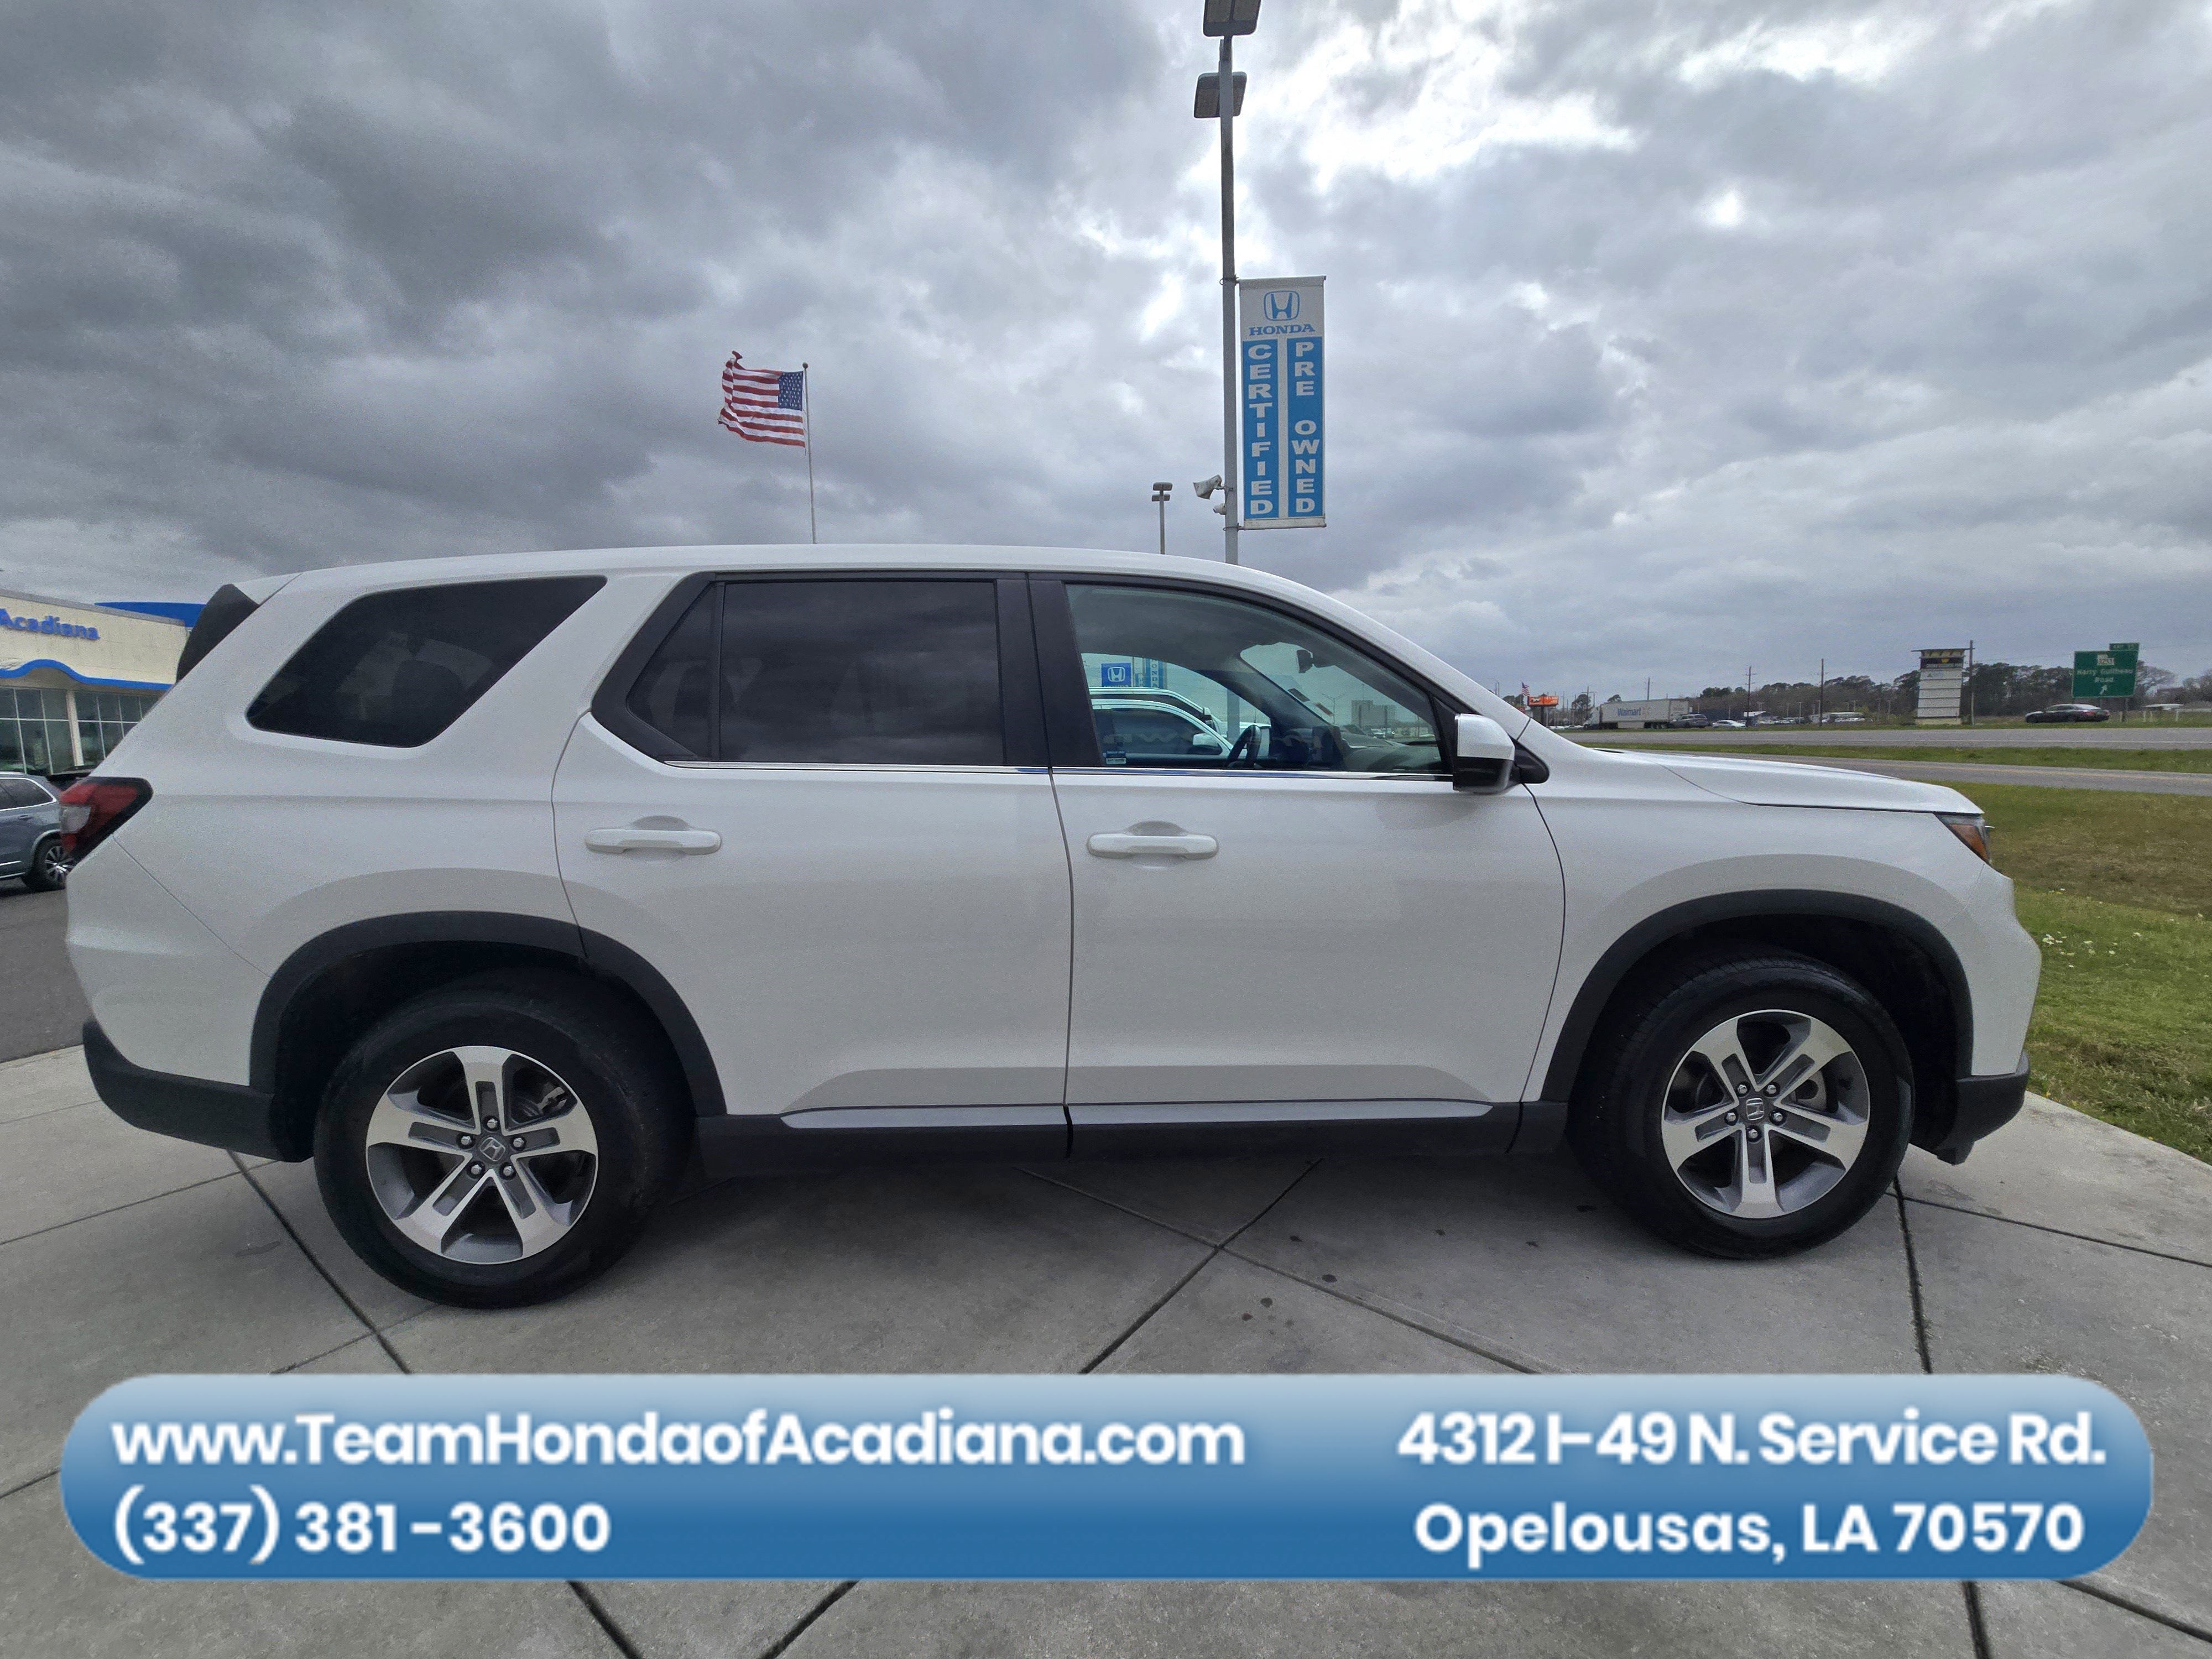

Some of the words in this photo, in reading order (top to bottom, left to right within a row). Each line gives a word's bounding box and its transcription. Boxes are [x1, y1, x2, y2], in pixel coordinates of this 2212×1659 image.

[1248, 324, 1316, 336] HONDA
[1295, 341, 1315, 397] PRE
[1248, 343, 1273, 515] CERTIFIED
[1291, 419, 1319, 513] OWNED
[1618, 708, 1641, 716] Walmart
